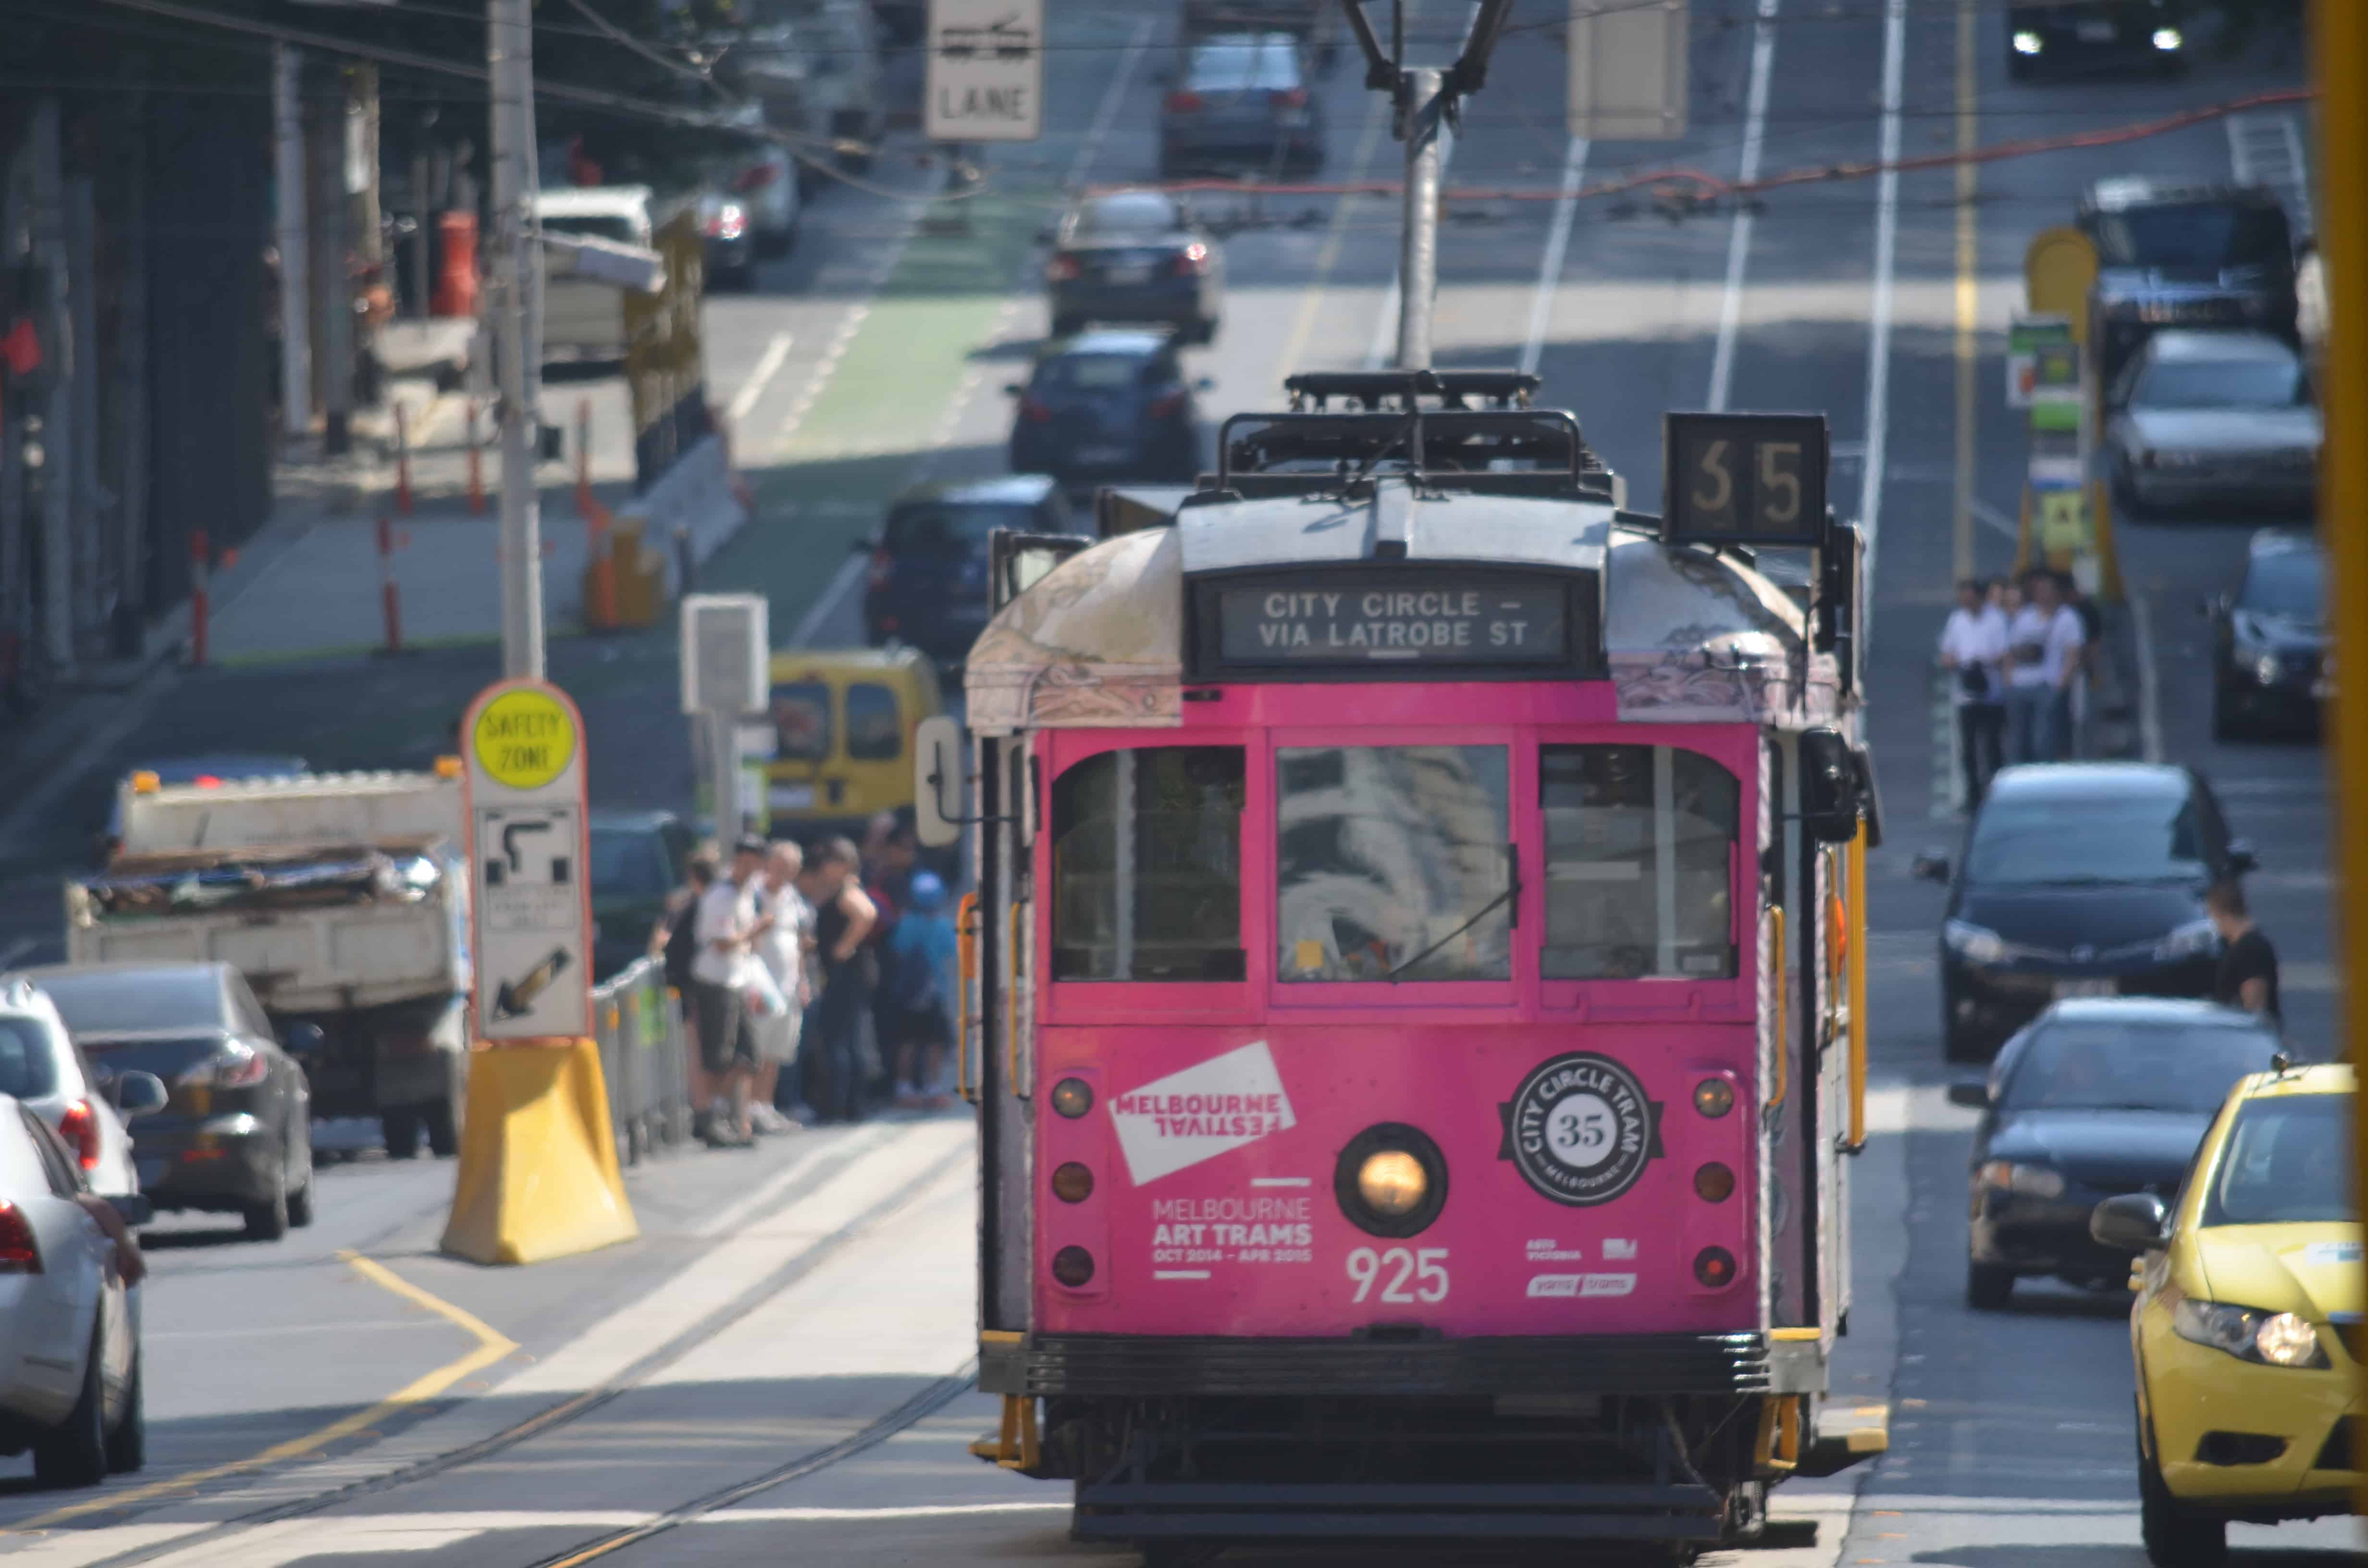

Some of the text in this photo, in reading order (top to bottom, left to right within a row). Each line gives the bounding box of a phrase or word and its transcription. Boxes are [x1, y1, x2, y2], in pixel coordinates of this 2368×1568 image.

[938, 86, 1030, 121] LANE
[1264, 593, 1341, 618] CITY
[1362, 592, 1480, 616] CIRCLE
[1259, 621, 1528, 646] VIA LATROBE ST
[484, 713, 561, 739] SAFETY
[501, 746, 551, 772] ZONE
[1115, 1093, 1282, 1115] MELBOURNE
[1522, 1067, 1640, 1153] CITY CIRCLE TRAM
[1154, 1116, 1282, 1137] FESTIVAL
[1557, 1114, 1604, 1147] 35
[1544, 1165, 1621, 1189] MELBOURNE
[1153, 1198, 1312, 1220] MELBOURNE
[1153, 1223, 1312, 1246] ART TRAMS
[1153, 1249, 1184, 1262] OCT
[1186, 1249, 1223, 1262] 2014
[1238, 1249, 1270, 1262] APR
[1347, 1247, 1450, 1304] 925
